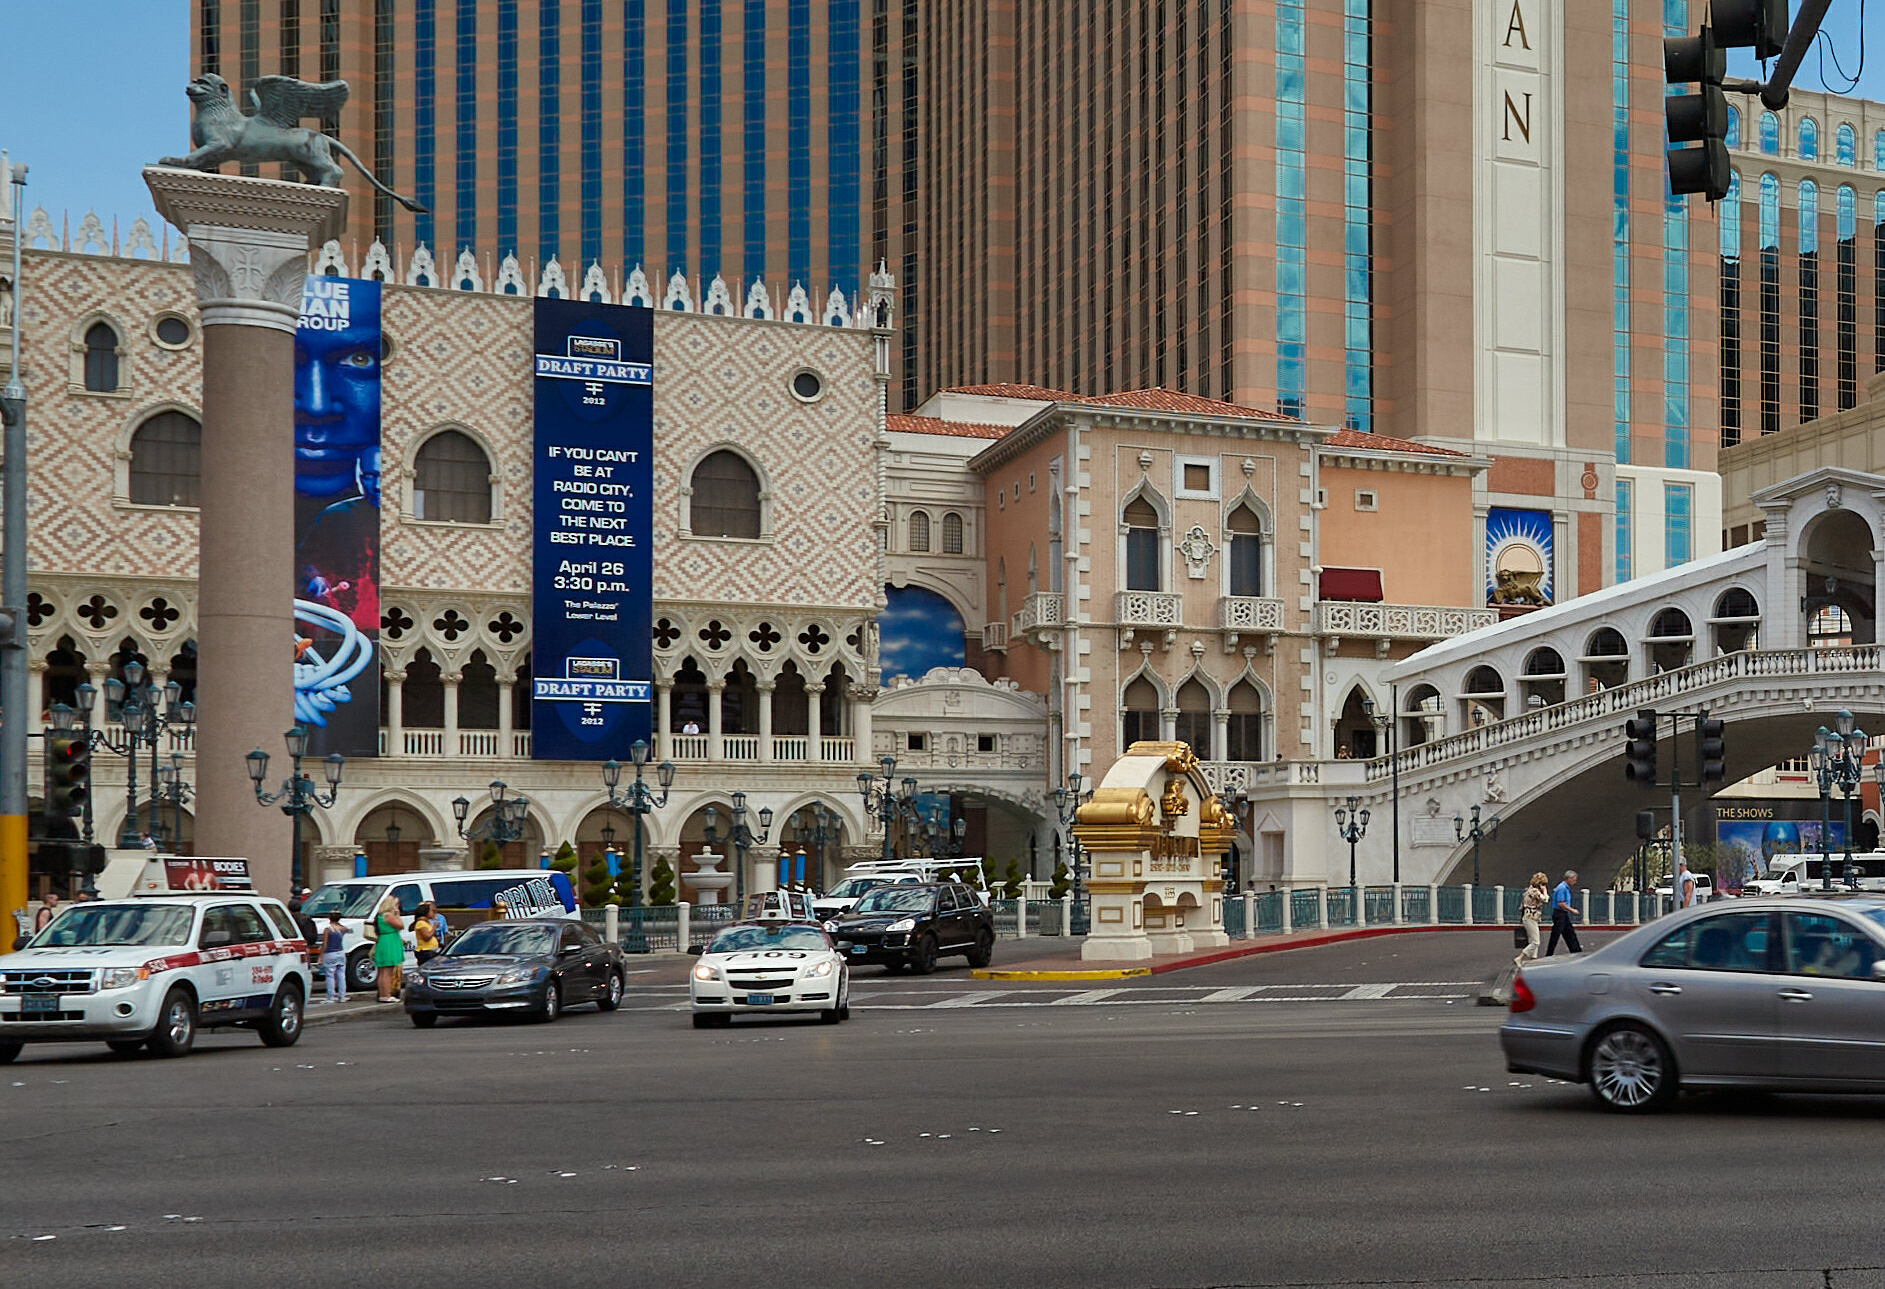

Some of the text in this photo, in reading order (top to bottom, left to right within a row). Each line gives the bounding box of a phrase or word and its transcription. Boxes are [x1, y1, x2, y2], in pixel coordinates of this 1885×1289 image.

[303, 281, 350, 300] LUE
[296, 316, 351, 332] ROUP
[538, 359, 650, 380] DRAFT PARTY
[582, 396, 606, 406] 2012
[549, 446, 639, 463] IF YOU CAN'T
[573, 465, 614, 478] BE AT
[553, 480, 634, 498] RADIO CITY,
[561, 498, 625, 513] COME TO
[559, 515, 628, 530] THE NEXT
[550, 531, 636, 547] BEST PLACE.
[558, 559, 625, 577] April 26
[553, 576, 630, 594] 3:30 p.m.
[564, 600, 581, 609] The
[565, 611, 618, 621] Lower Level
[536, 682, 648, 697] DRAFT PARTY
[581, 717, 604, 726] 2012
[1716, 808, 1774, 819] THE SHOWS
